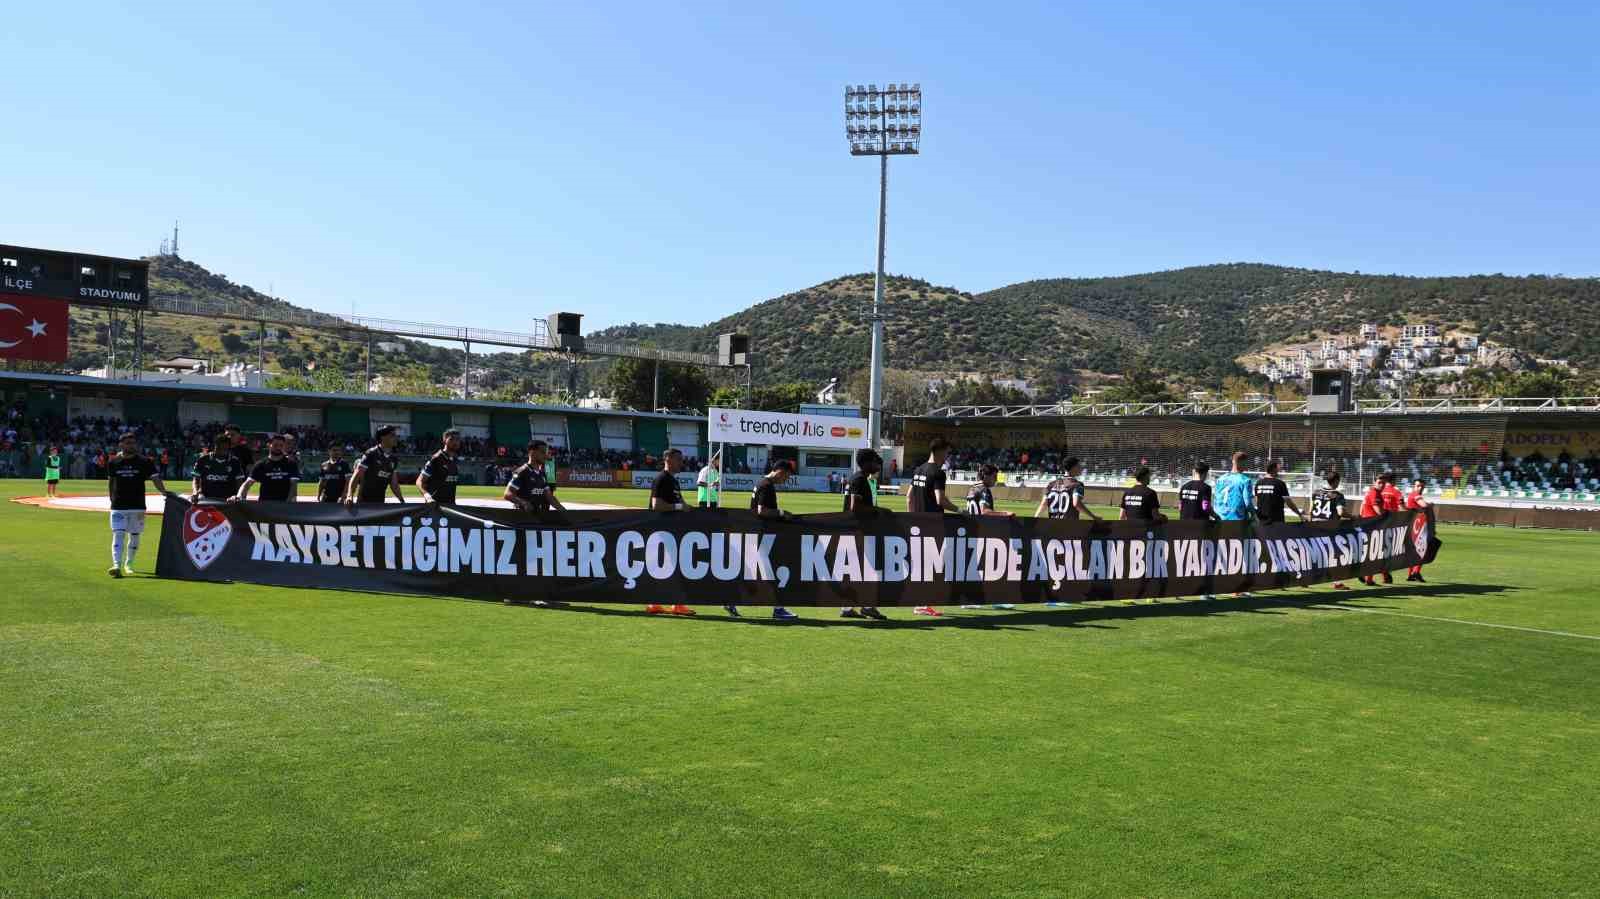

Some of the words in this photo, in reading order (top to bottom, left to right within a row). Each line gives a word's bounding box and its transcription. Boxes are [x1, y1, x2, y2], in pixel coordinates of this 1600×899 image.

[80, 287, 141, 301] STADYUMU
[740, 417, 799, 437] trendyol
[1047, 491, 1070, 513] 20
[1312, 499, 1331, 518] 34
[526, 529, 607, 579] HER
[615, 530, 790, 590] ÇOCUK,
[799, 526, 1024, 582] KALBİMİZDE
[1027, 538, 1125, 590] AÇILAN
[1128, 531, 1169, 579] BİR
[1174, 536, 1267, 577] YARADIR.
[1334, 527, 1368, 567] SAĞ
